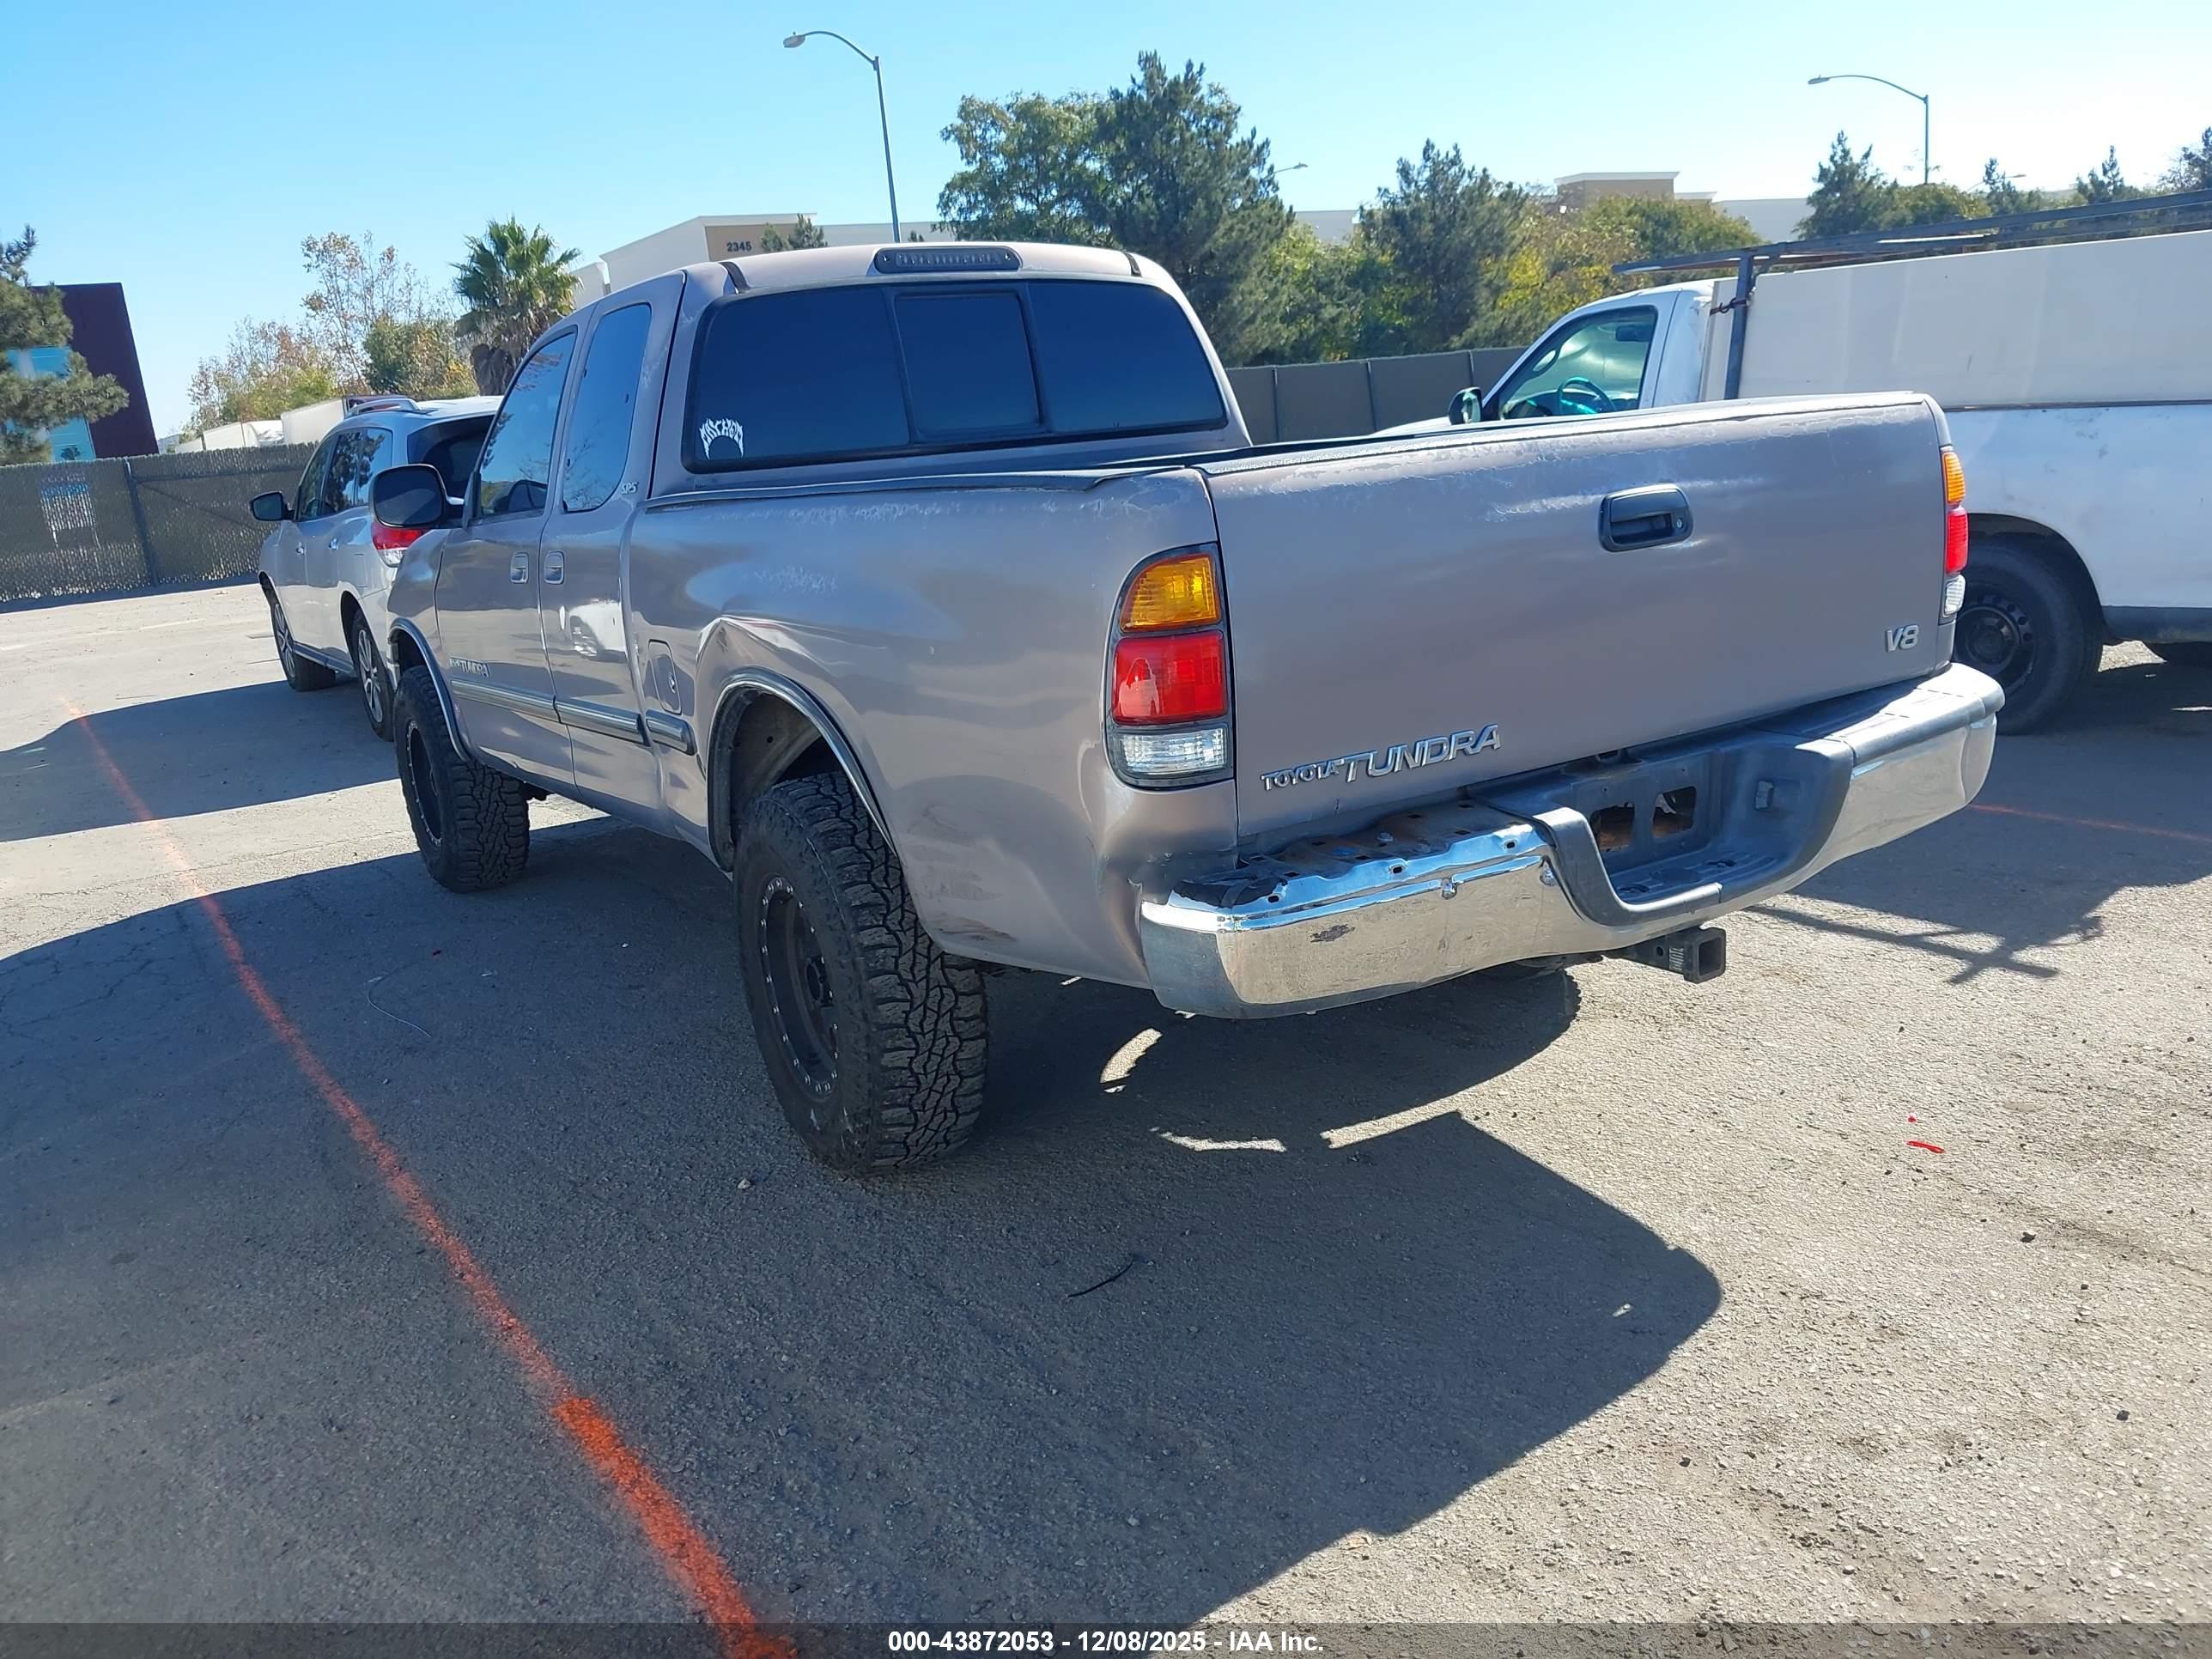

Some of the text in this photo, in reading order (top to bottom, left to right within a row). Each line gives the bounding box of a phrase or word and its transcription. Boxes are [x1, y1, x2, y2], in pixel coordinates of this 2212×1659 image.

[726, 241, 752, 252] 2345
[1885, 624, 1919, 653] V8
[1261, 723, 1502, 790] TOYOTA TUNDRA
